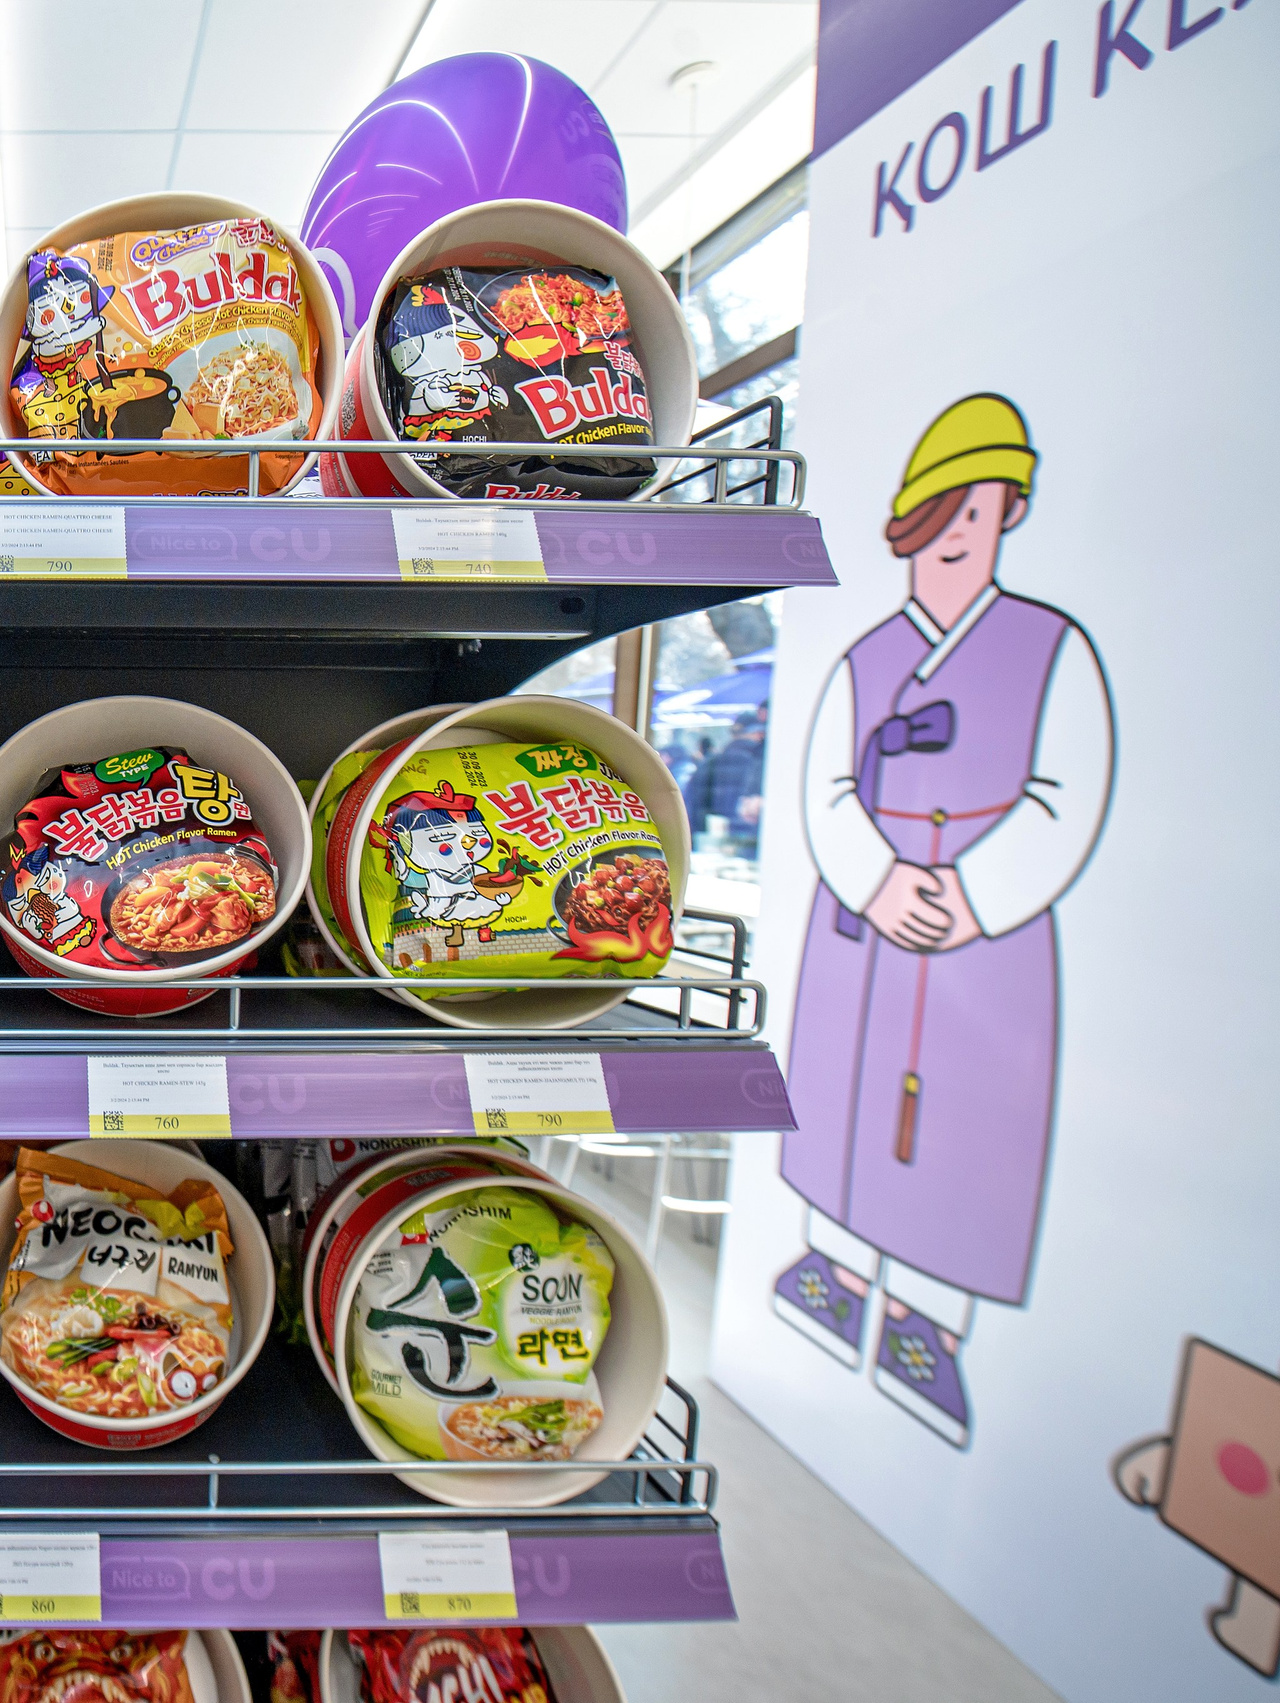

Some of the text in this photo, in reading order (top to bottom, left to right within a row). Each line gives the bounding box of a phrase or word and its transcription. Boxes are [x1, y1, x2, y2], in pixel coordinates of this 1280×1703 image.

[232, 304, 267, 317] Chicken
[576, 423, 646, 445] Chicken Flavor
[151, 534, 222, 550] Nice to
[249, 527, 332, 561] CU
[576, 529, 658, 566] CU
[47, 560, 72, 572] 790
[466, 563, 492, 575] 740
[105, 752, 154, 776] Stew
[526, 744, 589, 773] 짜장
[119, 763, 150, 778] TYPE
[105, 826, 237, 870] HOT Chicken Flavor Ramen
[542, 829, 640, 877] HOT Chicken Flavor
[230, 1074, 307, 1115] CU
[154, 1116, 179, 1130] 760
[537, 1113, 562, 1127] 790
[87, 1245, 158, 1274] 너구리
[167, 1257, 219, 1284] RAMYUN
[515, 1326, 592, 1367] 라면
[113, 1570, 176, 1588] Nice to
[202, 1557, 276, 1600] CU
[31, 1600, 55, 1614] 860
[447, 1596, 472, 1612] 870
